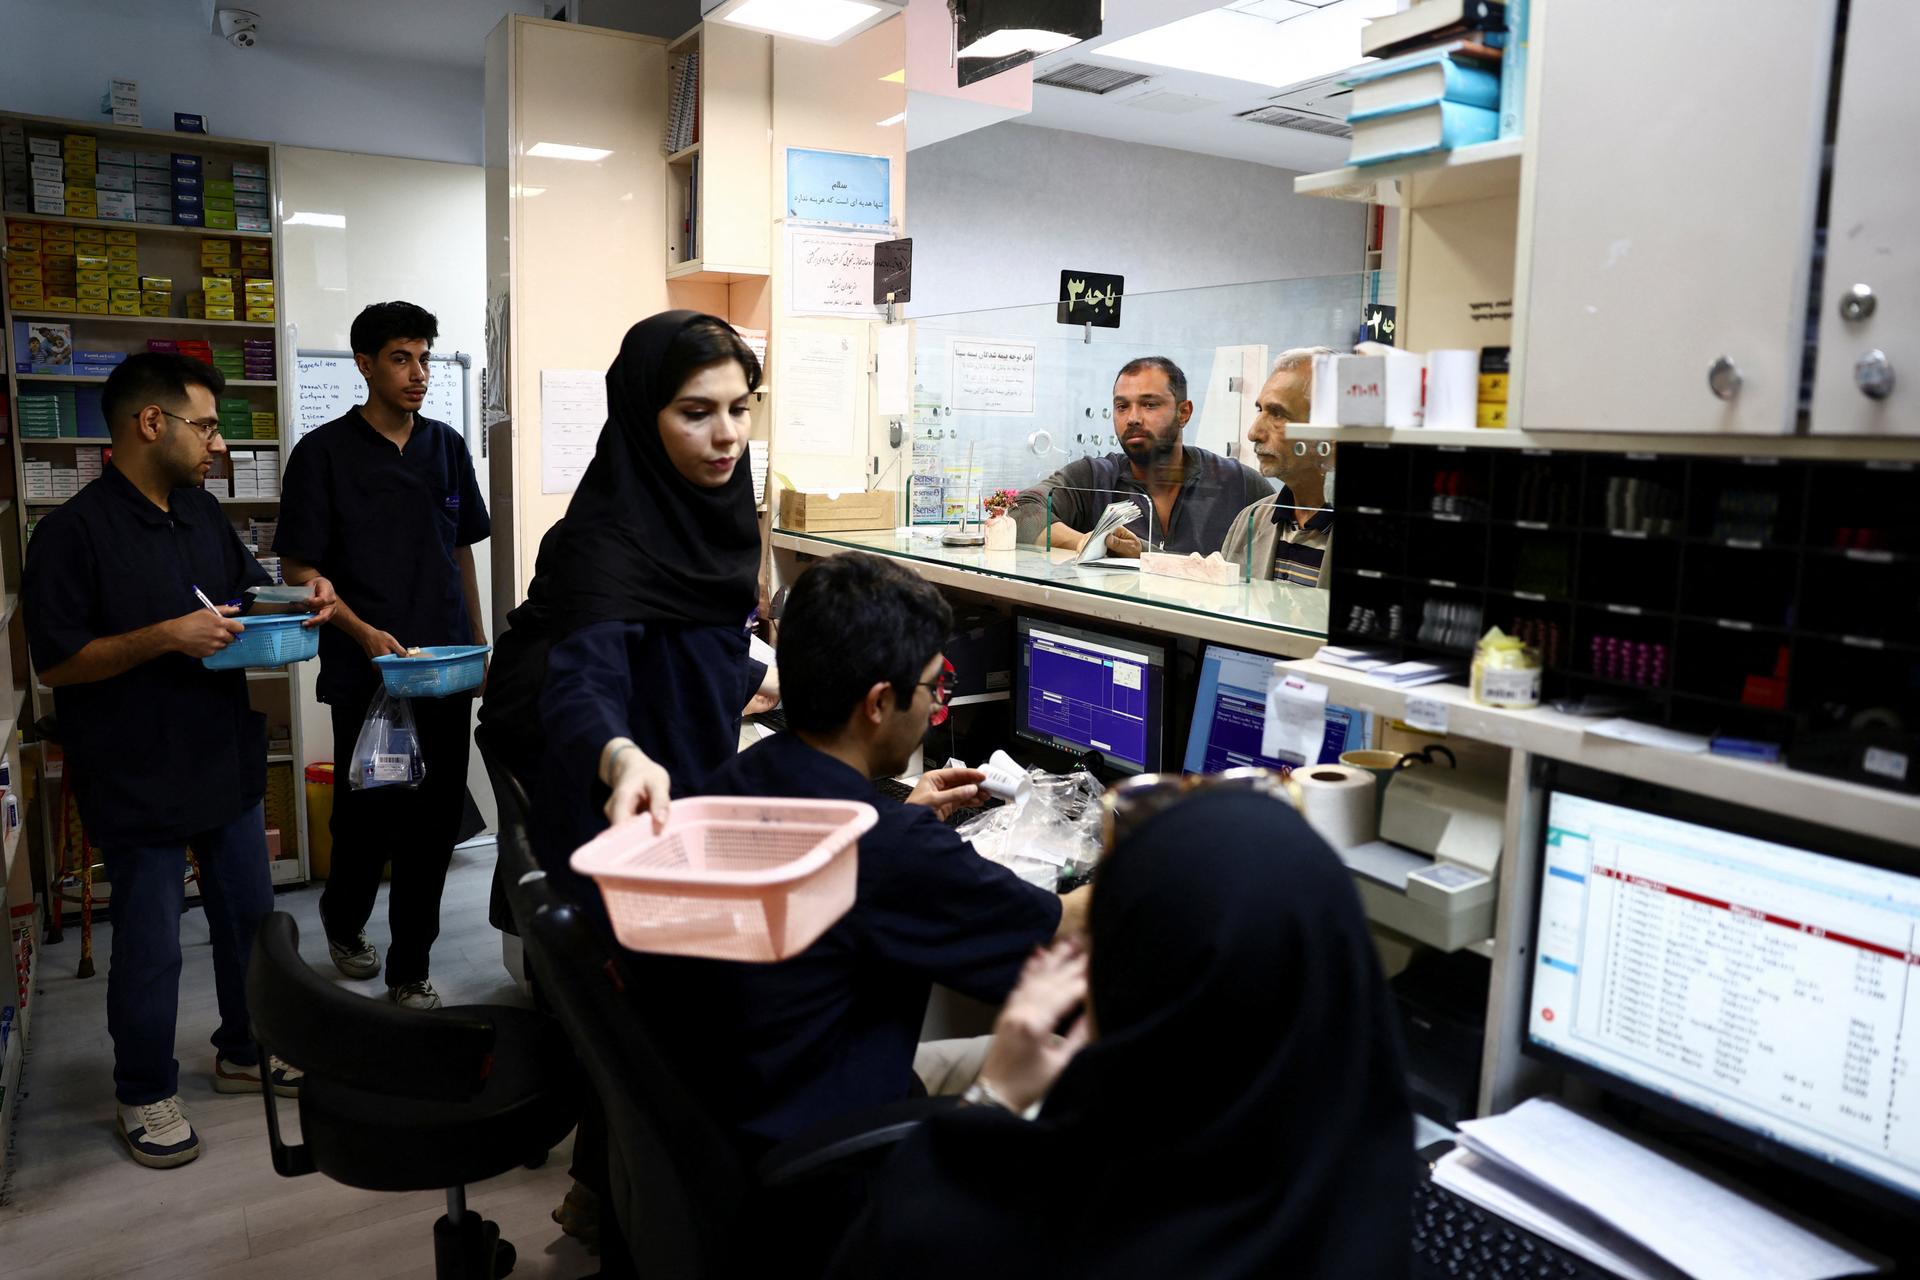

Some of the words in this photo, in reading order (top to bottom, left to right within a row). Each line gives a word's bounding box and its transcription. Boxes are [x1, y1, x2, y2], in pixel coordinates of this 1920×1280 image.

[831, 180, 848, 191] سلام
[826, 196, 834, 204] که
[835, 197, 848, 205] است
[849, 197, 858, 207] ای
[858, 200, 872, 208] هدیه
[873, 200, 884, 210] تنها
[1067, 277, 1085, 312] ۳
[1085, 283, 1116, 314] باجه
